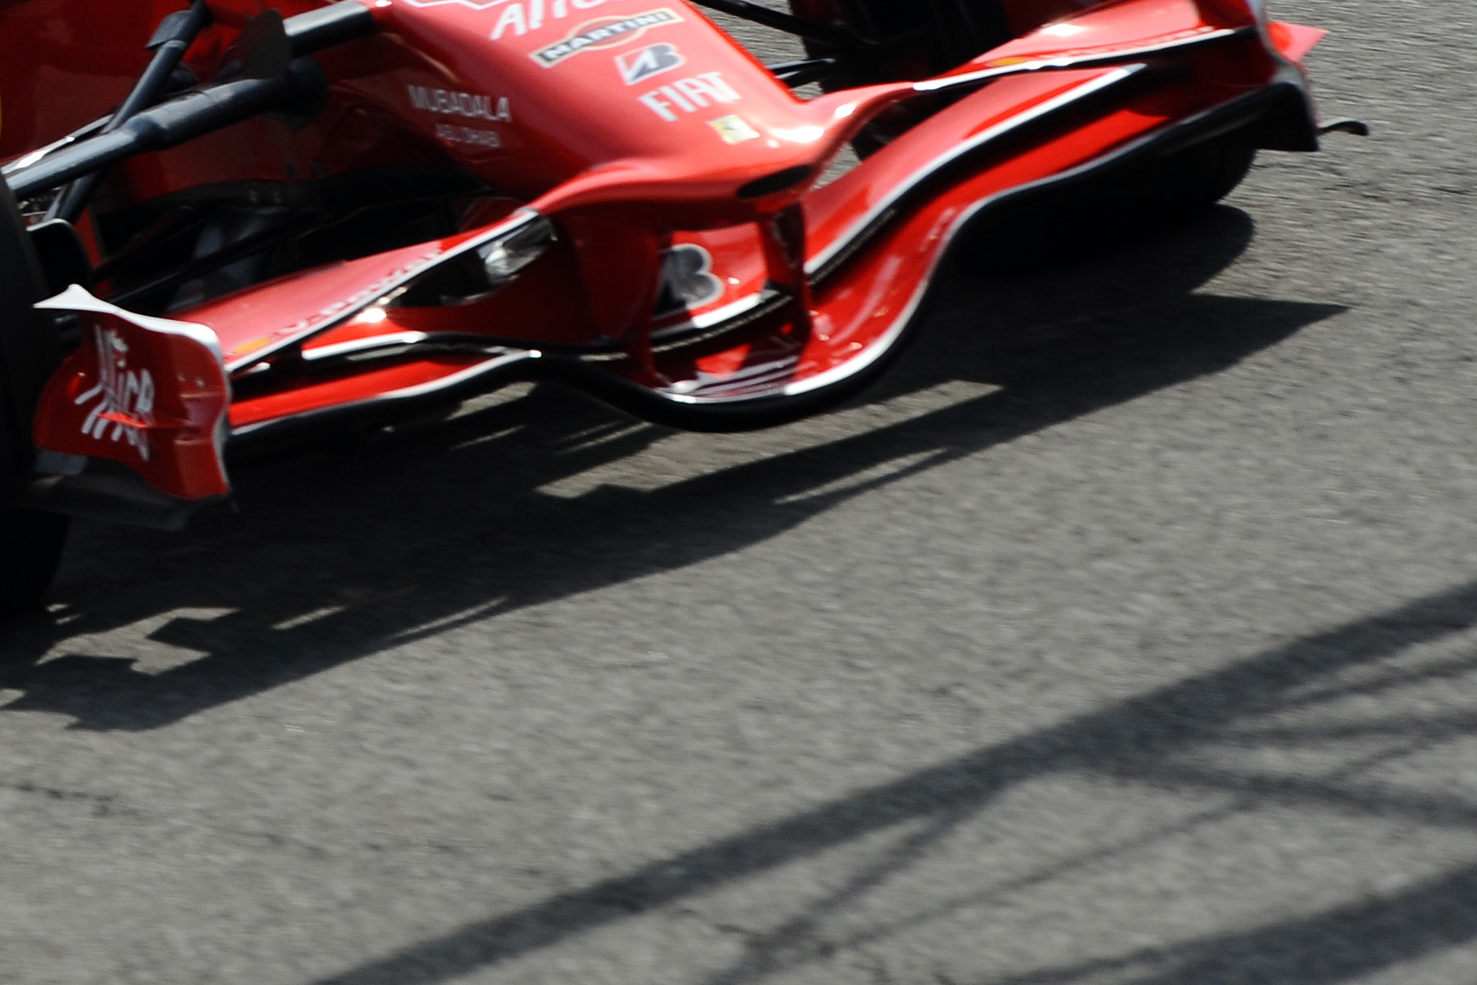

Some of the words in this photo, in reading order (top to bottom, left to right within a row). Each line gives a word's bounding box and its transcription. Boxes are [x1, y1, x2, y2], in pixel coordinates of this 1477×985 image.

[542, 10, 674, 61] MARTINI
[408, 85, 513, 123] MUBADALA
[638, 71, 741, 122] FIAT
